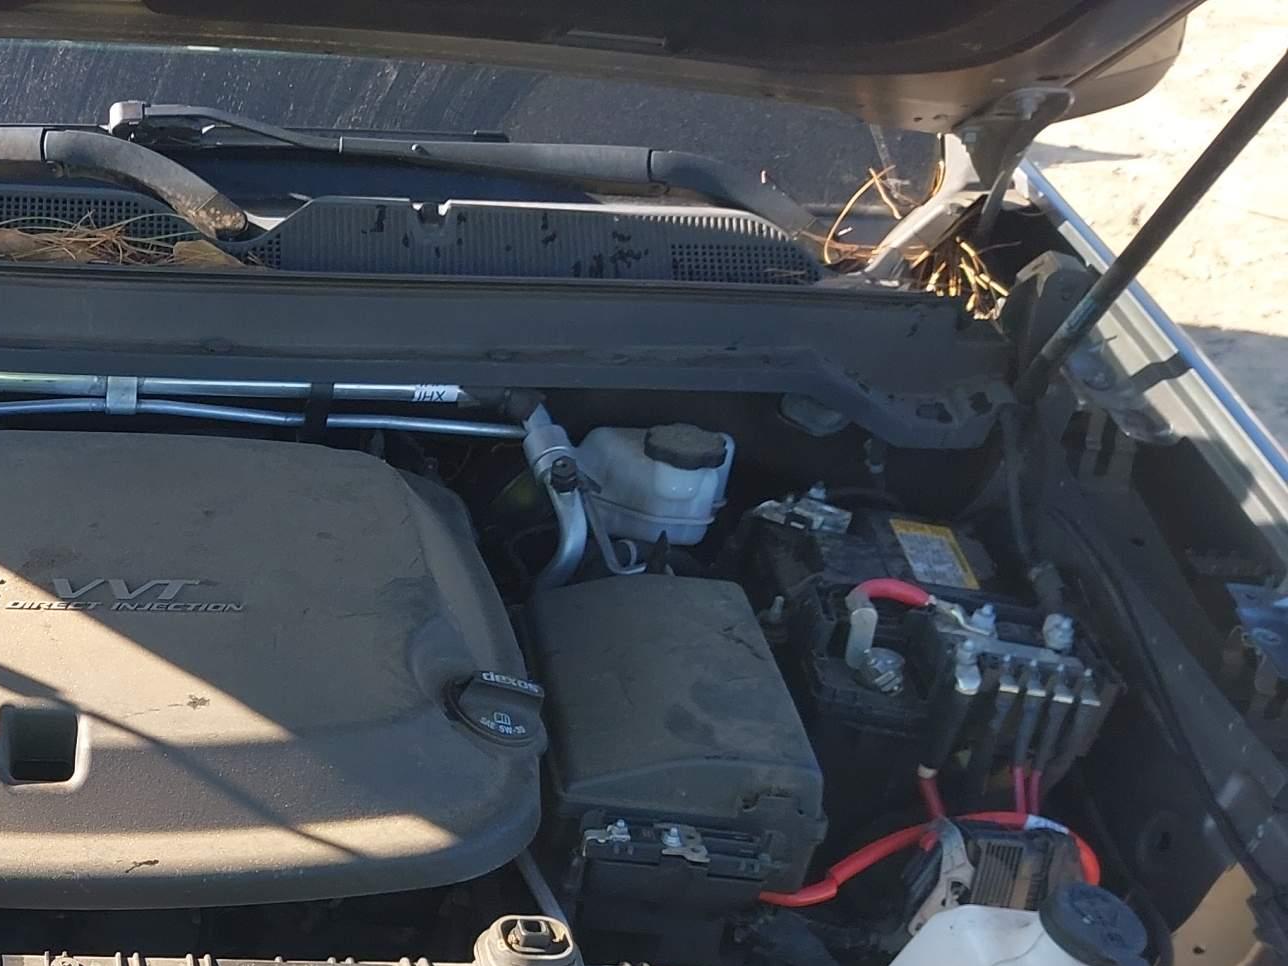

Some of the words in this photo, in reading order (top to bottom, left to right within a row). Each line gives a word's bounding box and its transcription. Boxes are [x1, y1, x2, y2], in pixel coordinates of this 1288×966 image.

[53, 577, 200, 601] VVT
[5, 600, 104, 611] DIRECT
[109, 601, 246, 613] INJECTION
[481, 671, 539, 693] dexos
